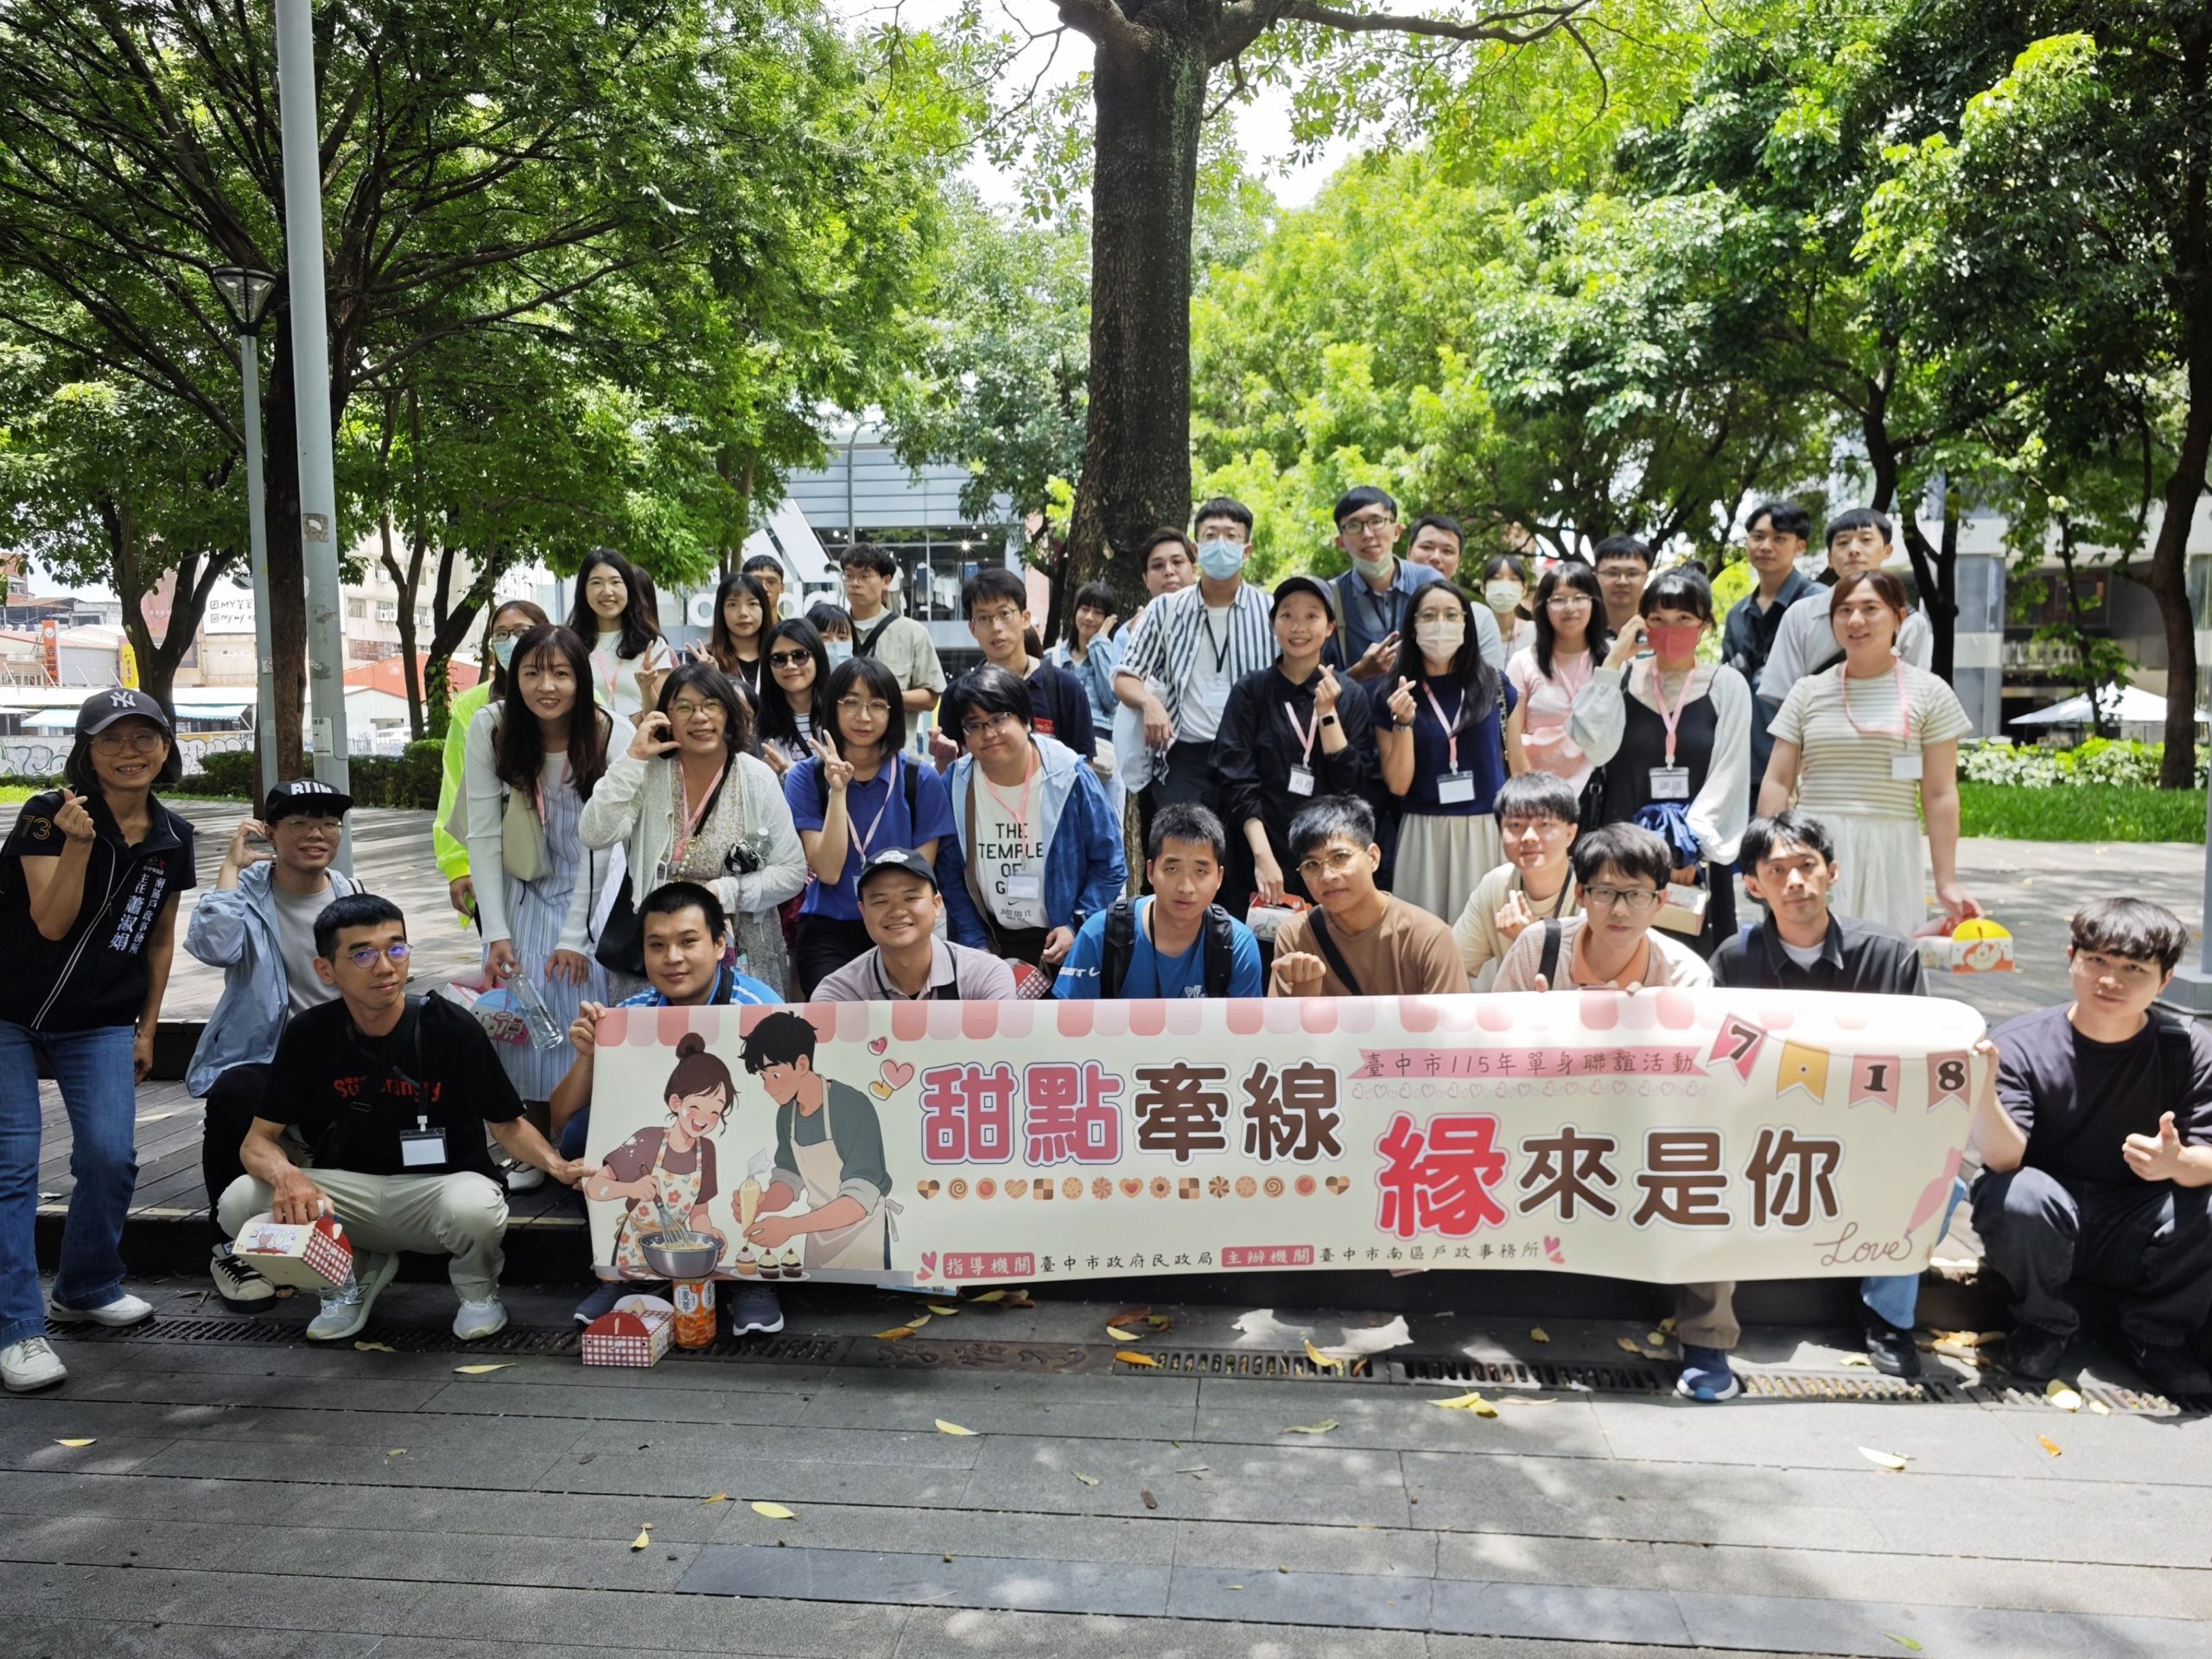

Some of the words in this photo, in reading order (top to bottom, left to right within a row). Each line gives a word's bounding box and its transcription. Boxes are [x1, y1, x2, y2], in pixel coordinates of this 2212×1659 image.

[21, 815, 52, 840] 73
[995, 823, 1028, 839] THE
[977, 842, 1044, 860] TEMPLE
[1001, 862, 1022, 878] OF
[1363, 1051, 1694, 1077] 臺中市115年單身聯誼活動
[923, 1060, 1343, 1164] 甜點牽線
[1813, 1222, 1913, 1267] Love
[946, 1255, 1032, 1275] 指導機關
[1039, 1251, 1213, 1273] 臺中市政府民政局
[1225, 1248, 1311, 1266] 主辦機關
[1319, 1242, 1540, 1263] 臺中市南區戶政事務所
